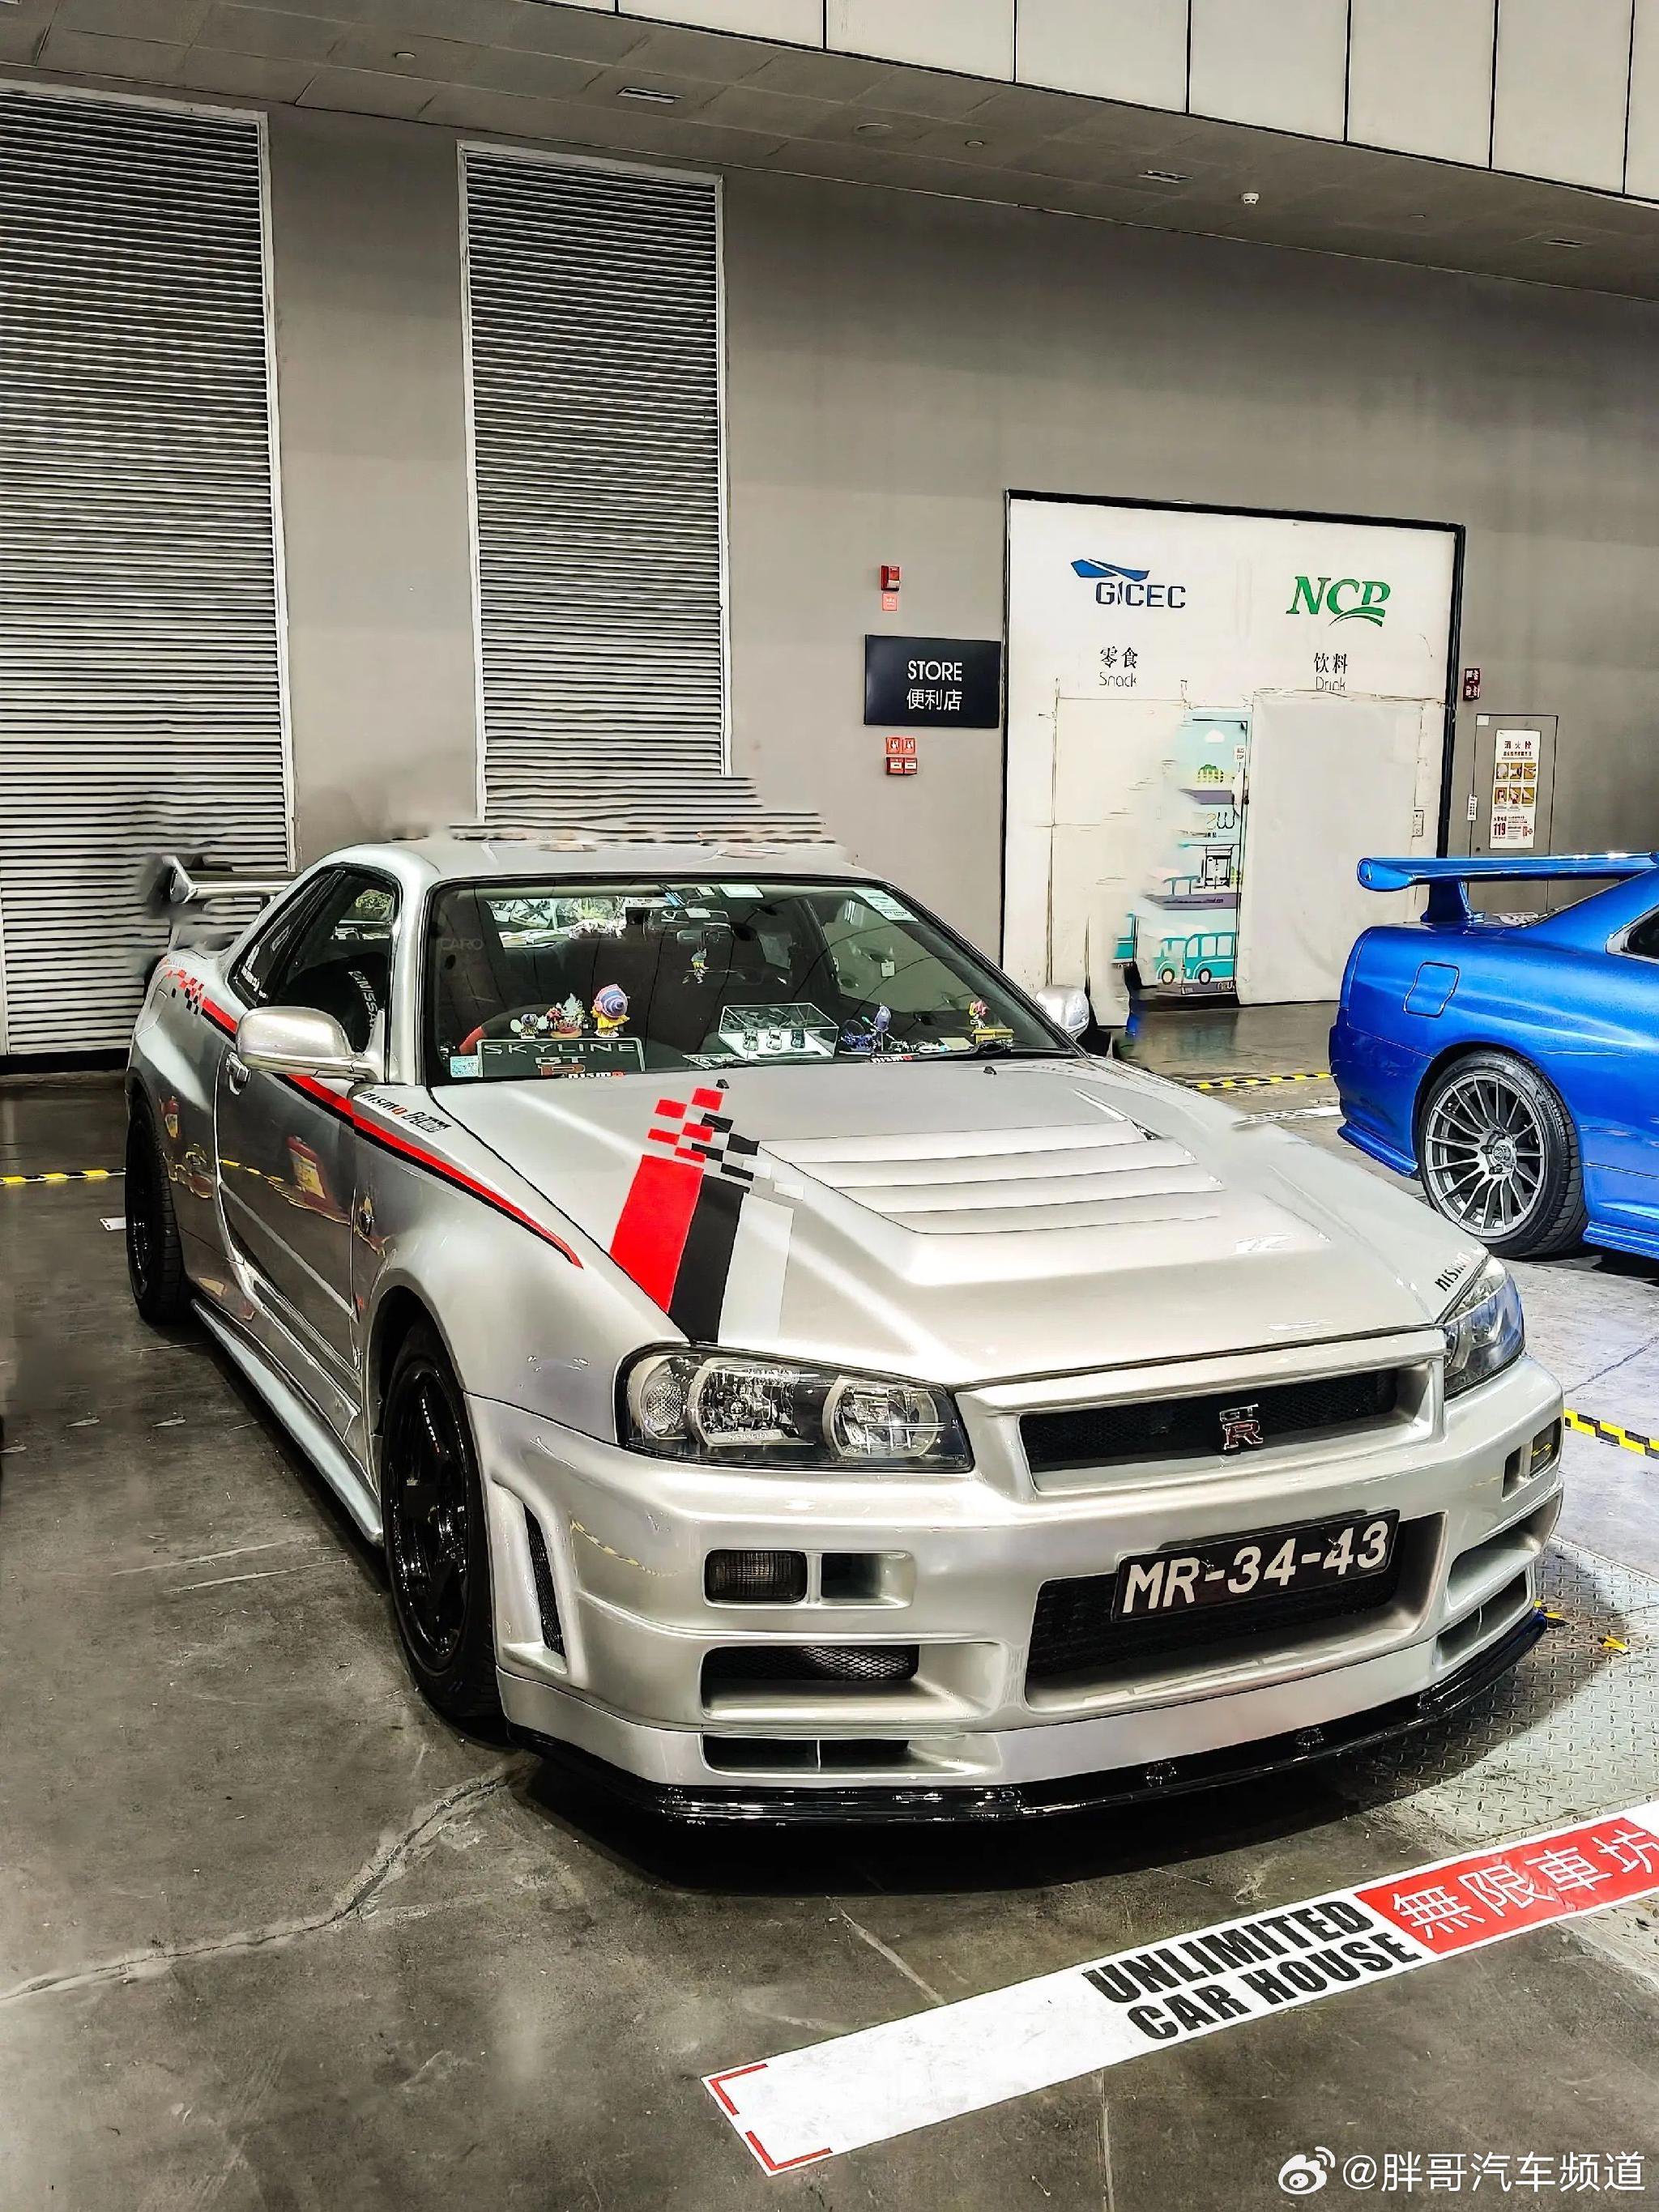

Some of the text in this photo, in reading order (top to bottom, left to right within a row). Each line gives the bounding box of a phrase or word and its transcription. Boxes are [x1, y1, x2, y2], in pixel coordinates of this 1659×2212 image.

[1095, 581, 1186, 609] GICEC
[1286, 576, 1392, 617] NCP
[1100, 646, 1138, 668] 零食
[1313, 652, 1348, 674] 饮料
[907, 659, 962, 682] STORE
[1098, 671, 1137, 688] Snack
[906, 688, 962, 711] 便利店
[484, 1043, 637, 1054] SKYLINE
[535, 1055, 587, 1064] GT
[360, 1093, 408, 1115] nismo
[1219, 1403, 1259, 1422] GT
[1222, 1419, 1264, 1451] R
[1122, 1520, 1390, 1614] MR-34-43
[1392, 1824, 1659, 1940] 無限車坊
[1081, 1900, 1375, 2004] UNLIMITED
[1127, 1931, 1423, 2041] CAR HOUSE
